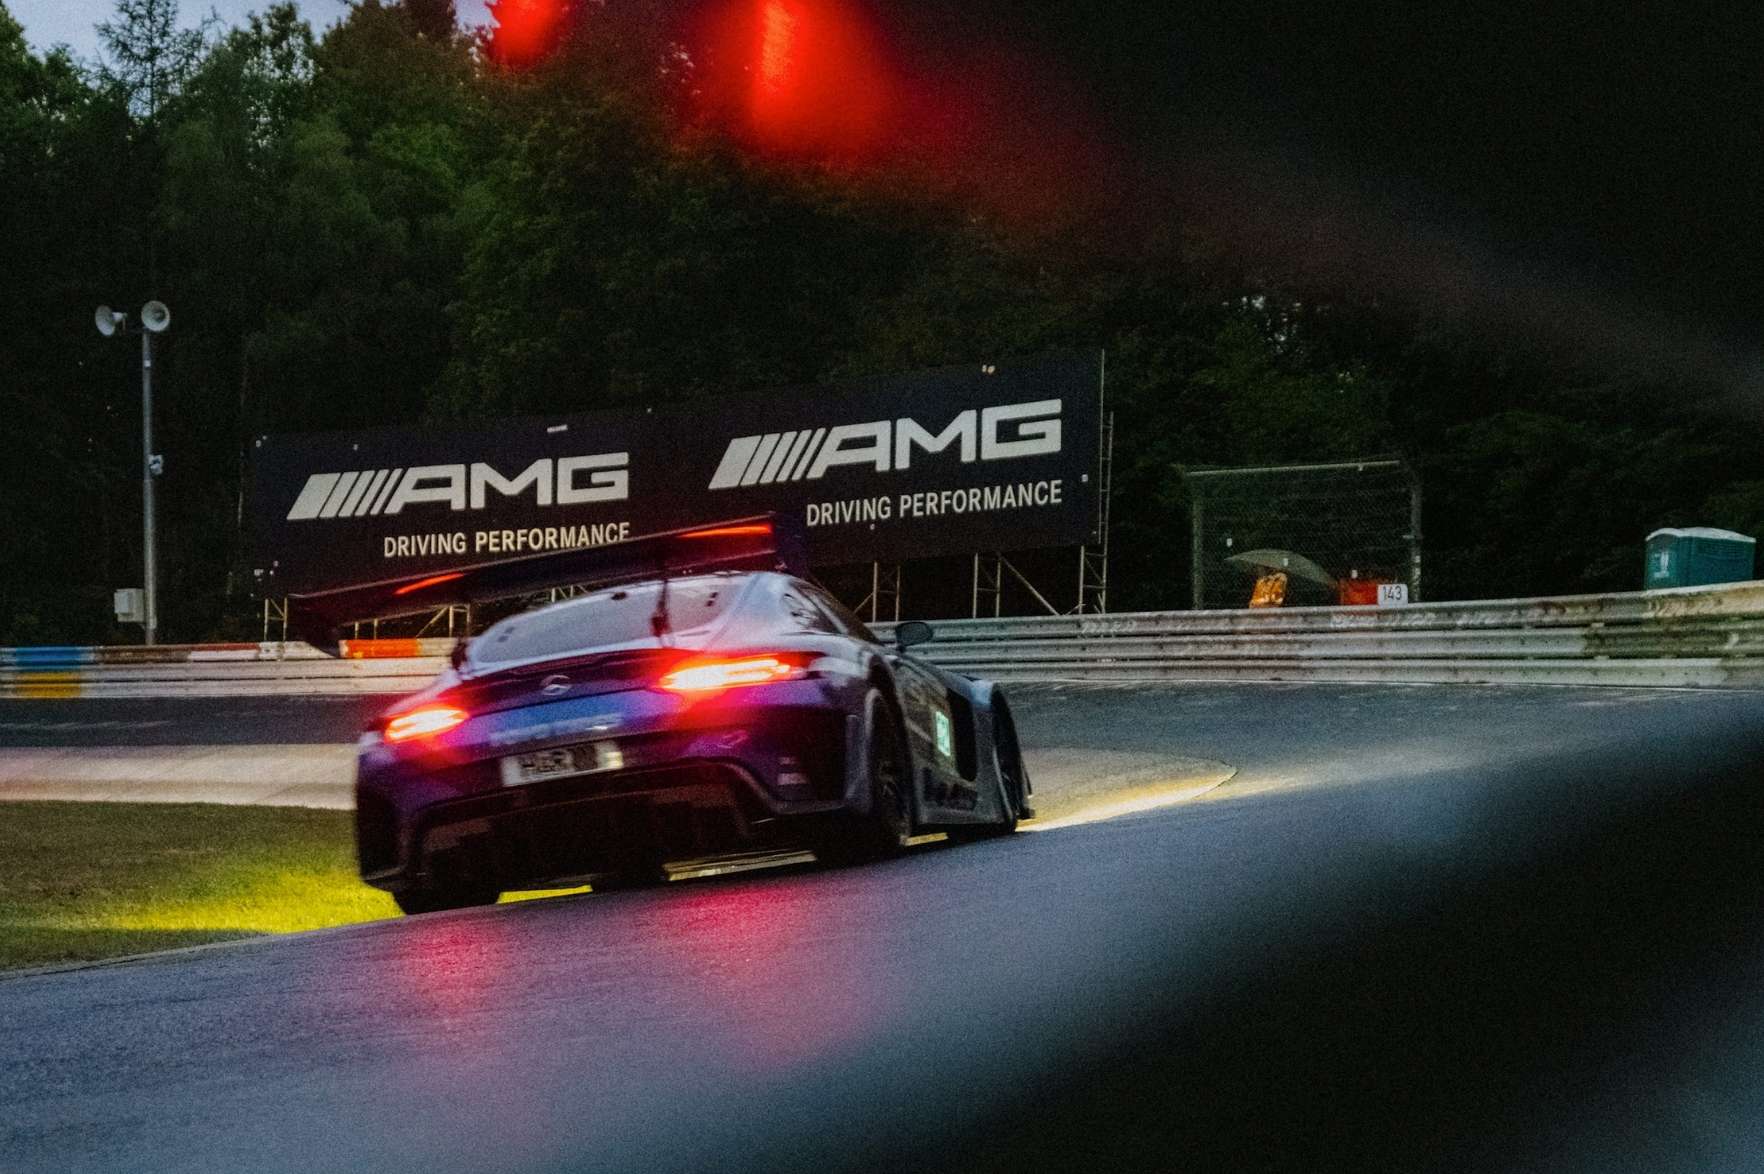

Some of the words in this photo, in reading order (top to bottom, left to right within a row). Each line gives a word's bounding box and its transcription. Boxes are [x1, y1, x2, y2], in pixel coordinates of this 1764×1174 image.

[806, 398, 1062, 480] AMG
[383, 451, 629, 515] AMG
[806, 496, 891, 527] DRIVING
[899, 479, 1062, 520] PERFORMANCE
[383, 531, 467, 558] DRIVING
[475, 521, 630, 553] PERFORMANCE
[1382, 585, 1402, 601] 143
